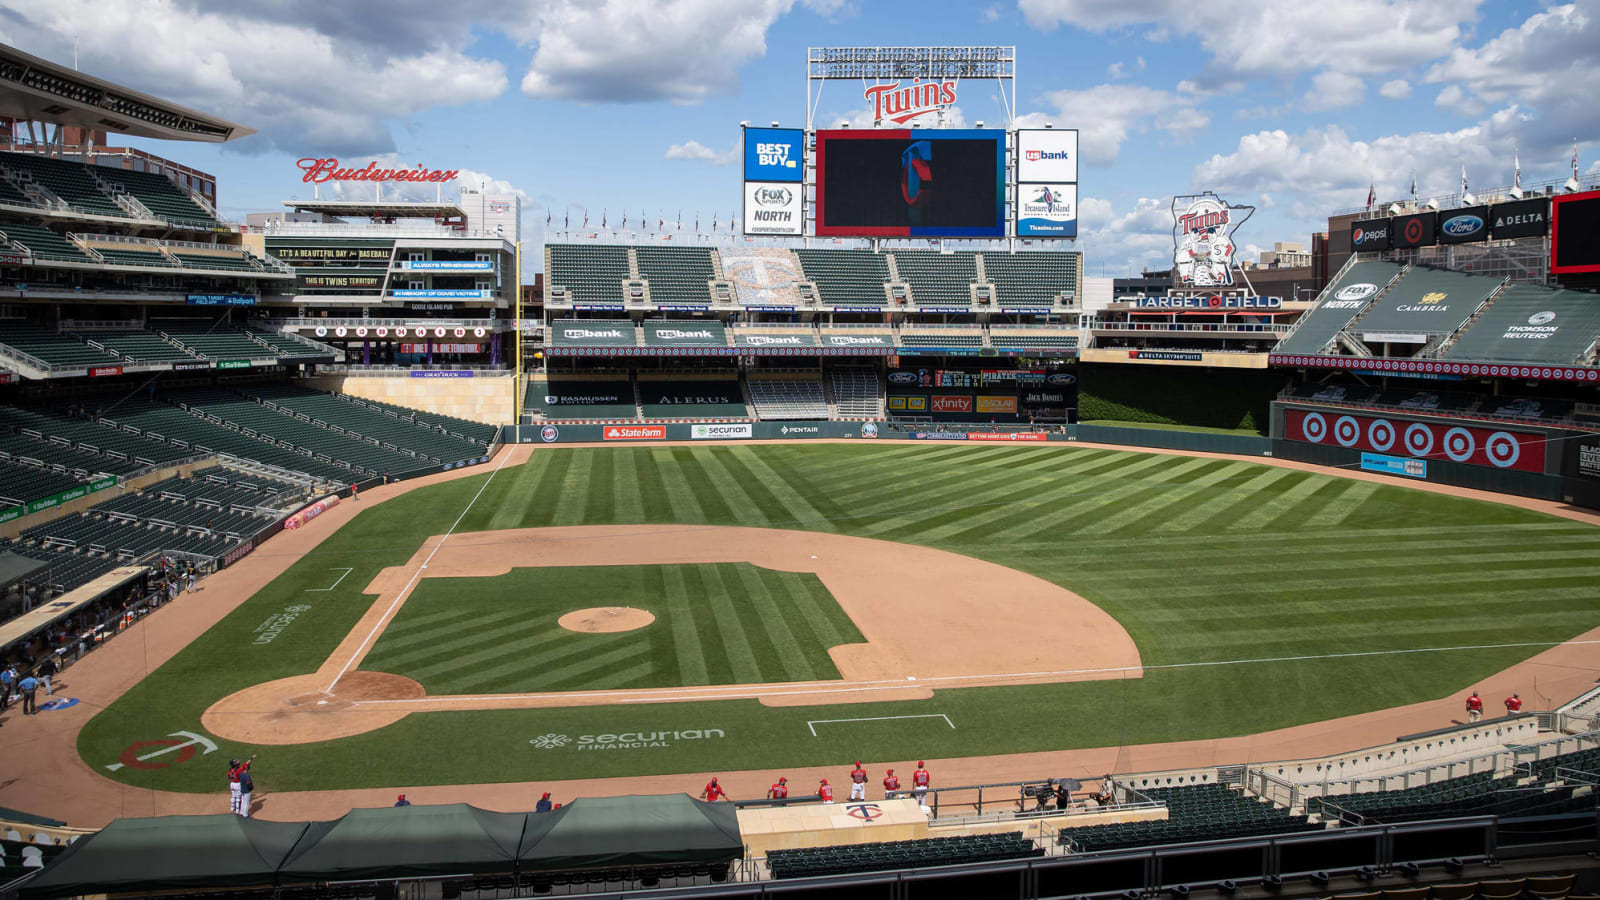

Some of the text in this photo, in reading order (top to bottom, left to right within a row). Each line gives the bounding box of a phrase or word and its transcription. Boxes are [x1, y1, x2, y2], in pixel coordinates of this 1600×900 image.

[865, 77, 957, 122] Twins
[756, 143, 792, 155] BEST
[758, 154, 788, 166] BUY
[296, 157, 460, 183] Budweiser
[762, 189, 785, 200] FOX
[1024, 203, 1071, 213] Treasure Island
[754, 210, 792, 222] NORTH
[1178, 208, 1229, 236] Twins
[1506, 213, 1544, 226] DELTA
[1449, 219, 1476, 233] Ford
[1364, 228, 1388, 242] pepsi
[279, 249, 294, 257] IT'S
[300, 249, 335, 258] BEAUTIFUL
[335, 250, 347, 258] DAY
[359, 250, 390, 258] BASEBALL
[325, 277, 348, 286] TWINS
[349, 277, 378, 285] TERRITORY
[1344, 286, 1370, 294] FOX
[1139, 296, 1282, 308] TARGET FIELD
[1321, 300, 1365, 309] NORTH
[1396, 304, 1448, 312] CAMBRIA
[983, 372, 1017, 380] PIRATES
[660, 395, 729, 404] ALERUS
[934, 397, 970, 411] xfinity
[708, 425, 747, 434] securian
[1580, 444, 1600, 454] BLAC
[1580, 451, 1600, 463] LIVE
[576, 728, 726, 746] securian
[577, 741, 671, 751] FINANCIAL
